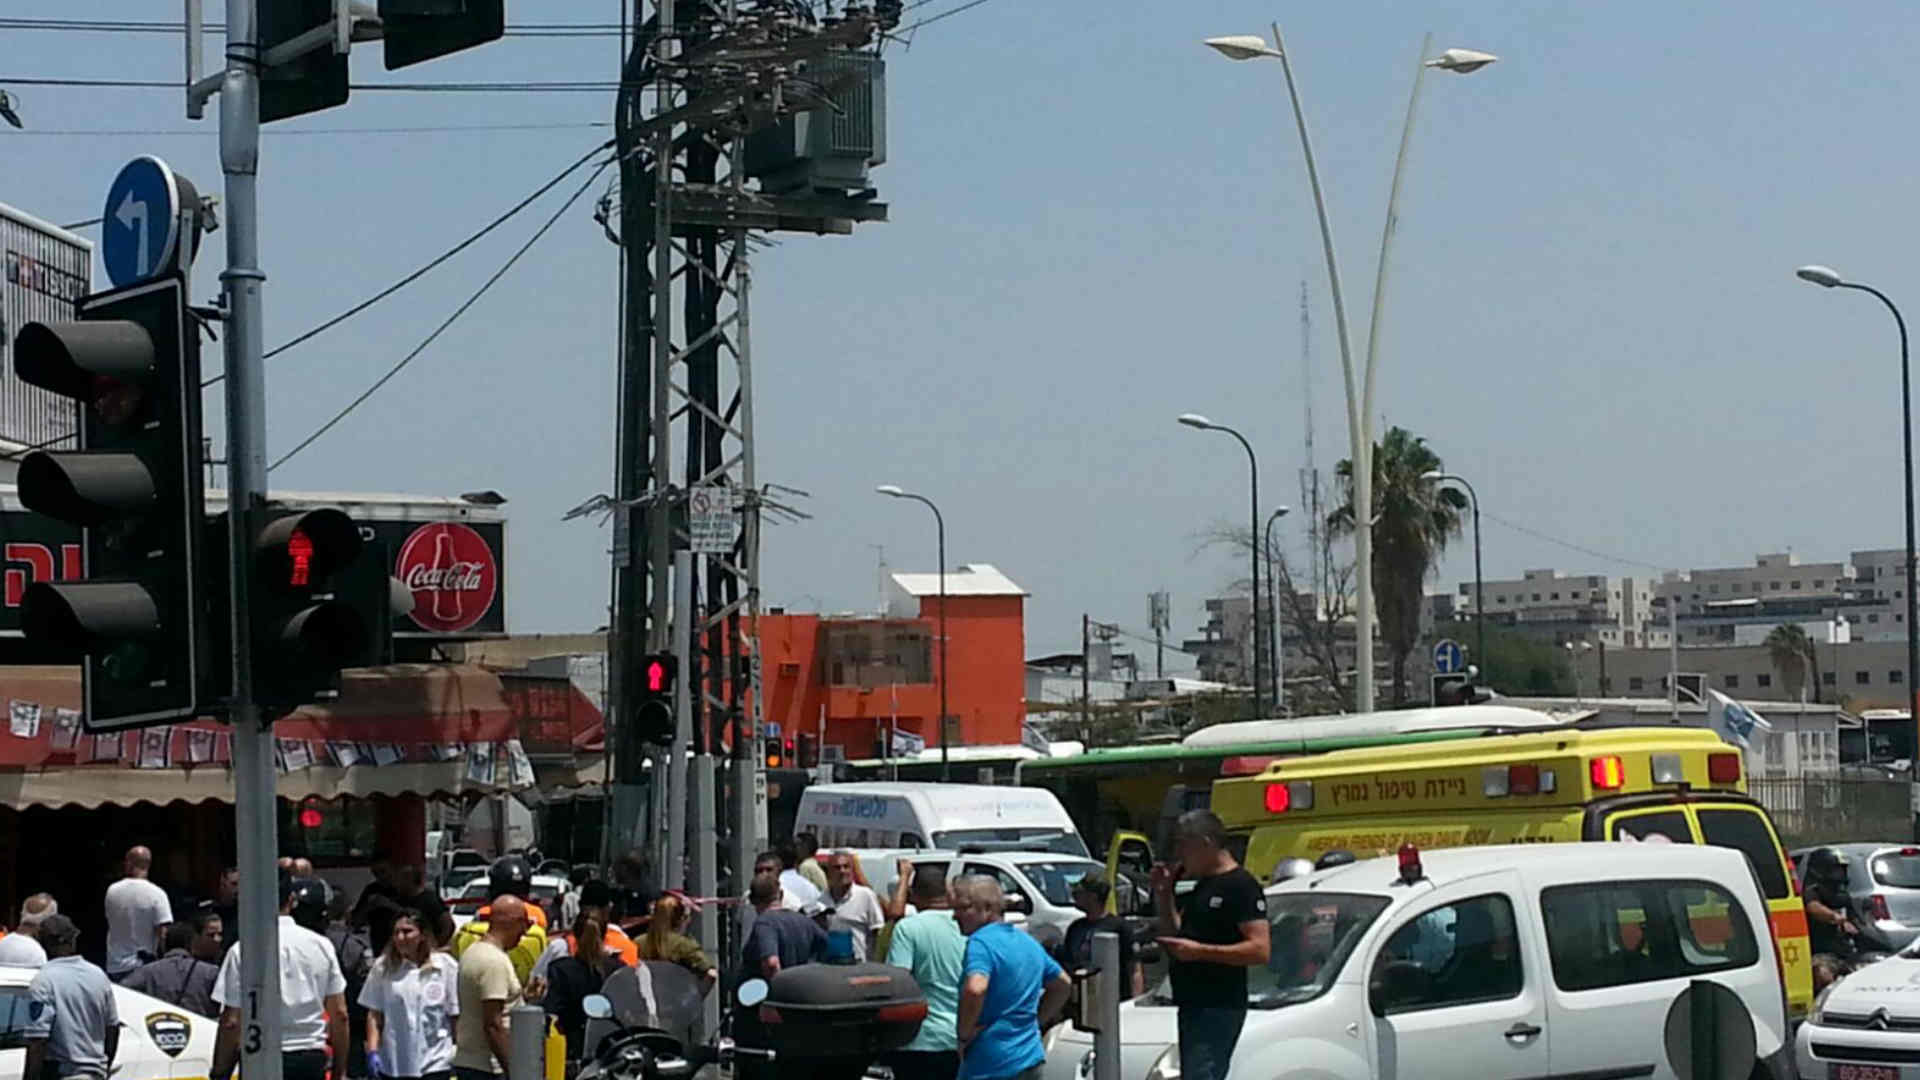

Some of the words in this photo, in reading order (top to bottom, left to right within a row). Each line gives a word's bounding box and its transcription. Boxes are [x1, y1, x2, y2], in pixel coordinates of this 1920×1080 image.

[1331, 783, 1369, 806] נמרץ
[1375, 775, 1416, 800] טיפול
[1424, 777, 1466, 797] ניידת
